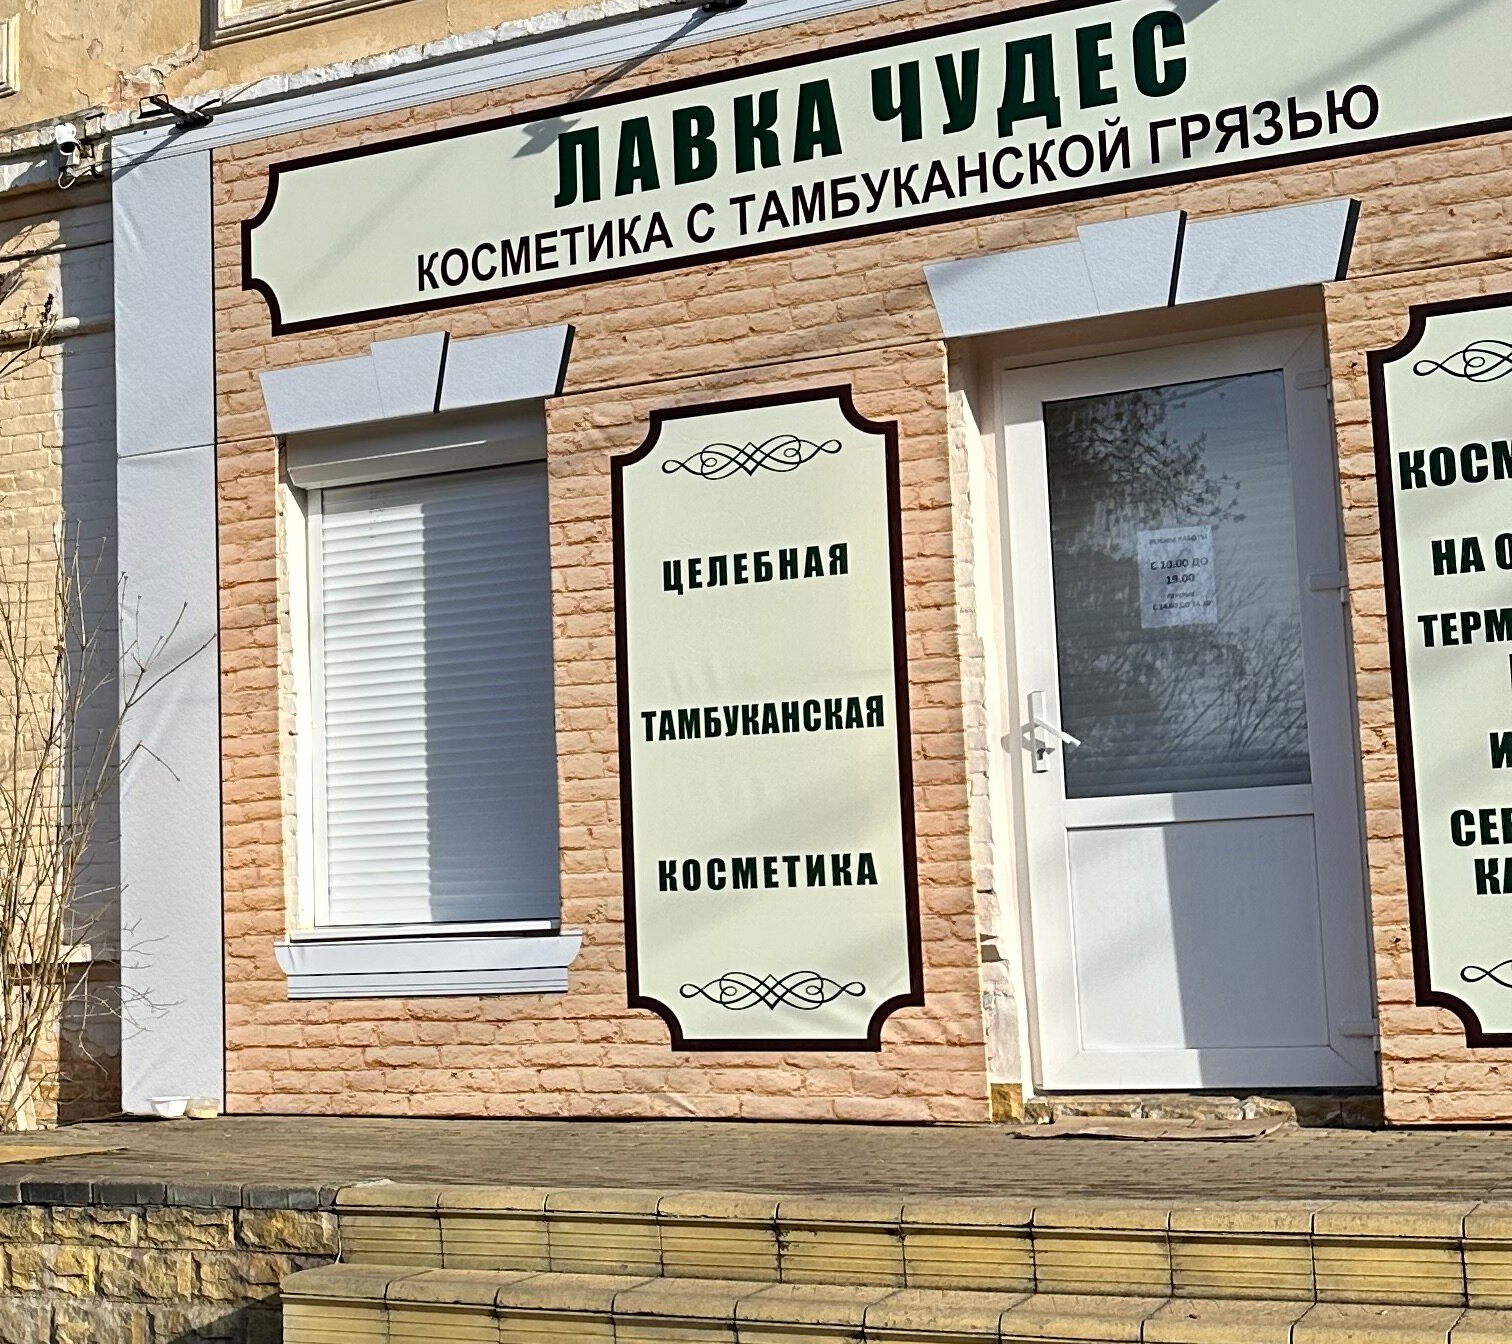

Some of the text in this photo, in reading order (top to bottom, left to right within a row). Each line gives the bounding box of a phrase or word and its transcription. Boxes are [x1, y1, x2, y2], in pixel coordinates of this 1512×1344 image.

[554, 10, 1188, 209] ЛАВКА ЧУДЕС
[417, 84, 1380, 293] КОСМЕТИКА С ТАМБУКАНСКОЙ ГРЯЗЬЮ
[662, 542, 849, 596] ЦЕЛЕБНАЯ
[1161, 558, 1189, 569] 10.00
[1192, 557, 1209, 567] ДО
[1431, 536, 1486, 576] НА
[1417, 607, 1512, 648] ТЕРМ
[640, 694, 885, 743] ТАМБУКАНСКАЯ
[658, 852, 878, 892] КОСМЕТИКА
